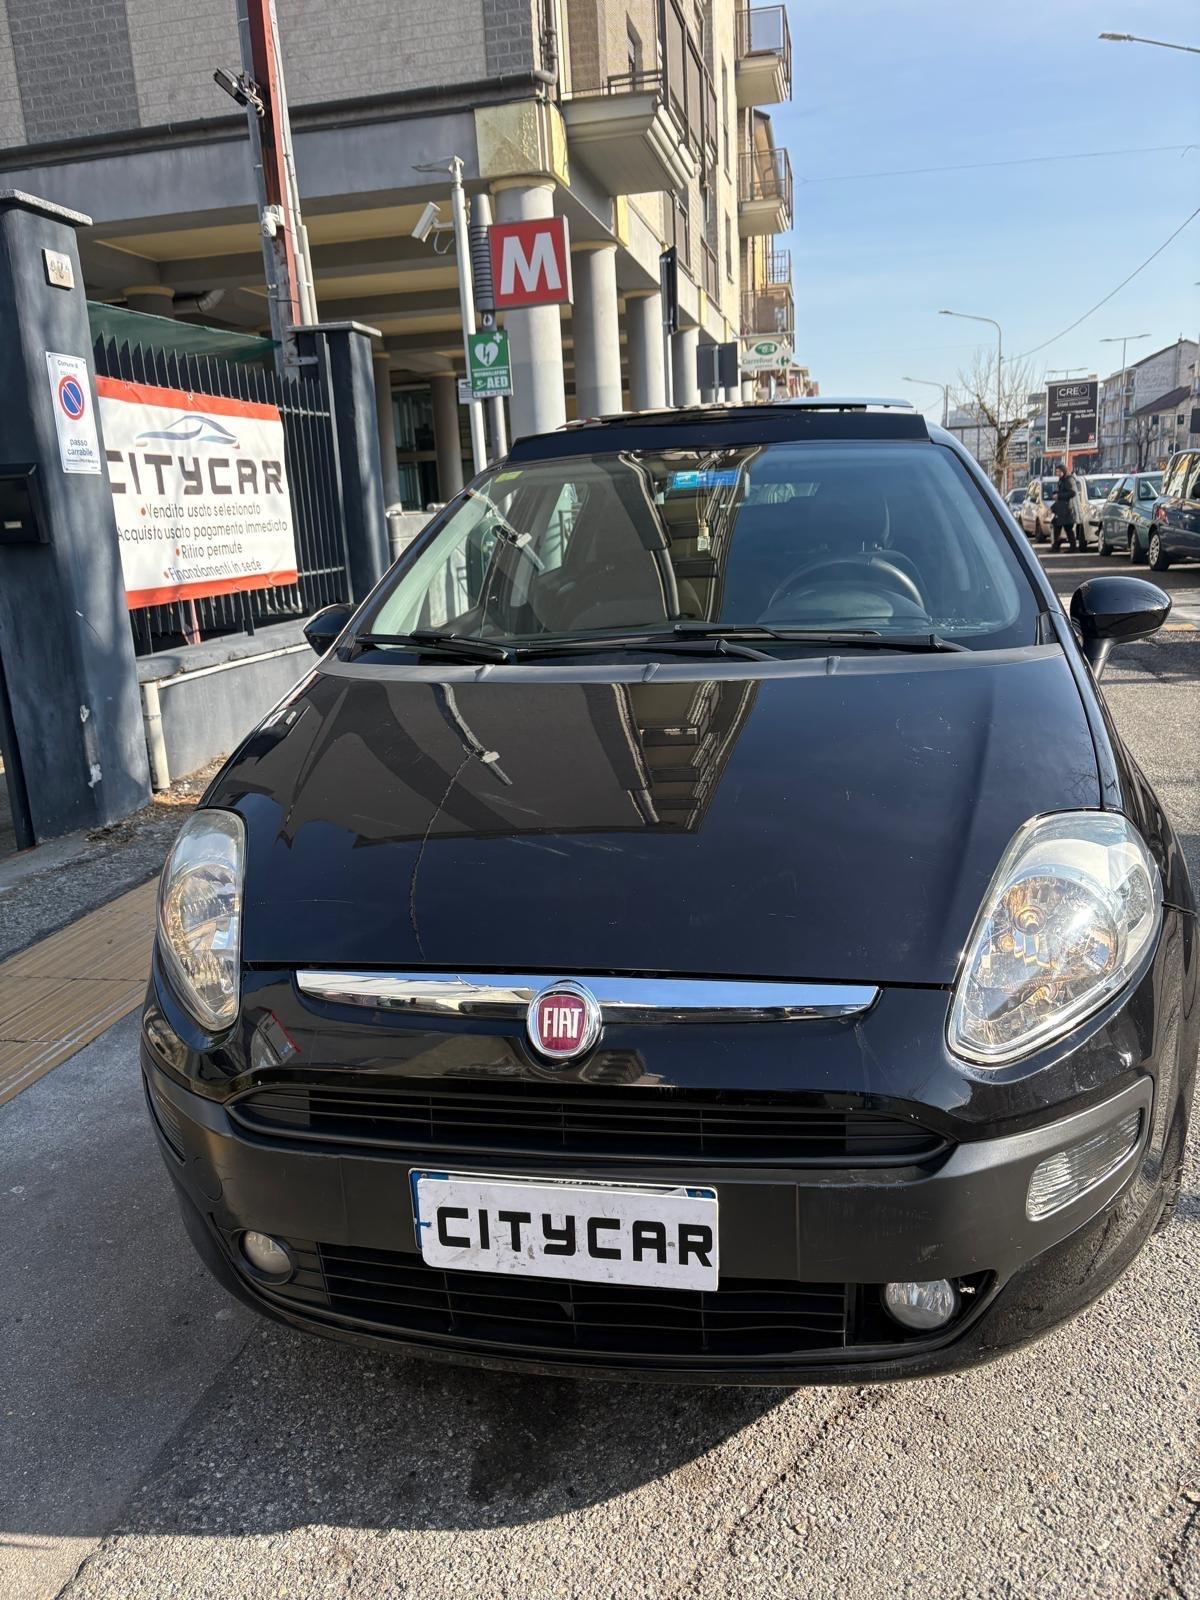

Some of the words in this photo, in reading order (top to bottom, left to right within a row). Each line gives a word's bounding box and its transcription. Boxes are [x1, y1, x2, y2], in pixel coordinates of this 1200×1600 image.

[500, 231, 562, 295] M
[486, 375, 509, 389] AED
[67, 447, 93, 457] carrabile
[70, 438, 88, 447] passo
[146, 503, 184, 519] Vendita
[187, 506, 212, 518] usato
[213, 503, 261, 517] selezionato
[117, 525, 163, 544] Acquisto
[165, 525, 191, 540] usato
[194, 523, 244, 540] pagamento
[245, 519, 288, 533] immediato
[181, 543, 205, 560] Ritiro
[207, 541, 243, 559] permute
[168, 563, 231, 582] Finanziamenti
[231, 561, 241, 572] in
[241, 558, 262, 573] sede
[543, 1007, 582, 1039] FIAT
[436, 1206, 713, 1268] CITYCAR
